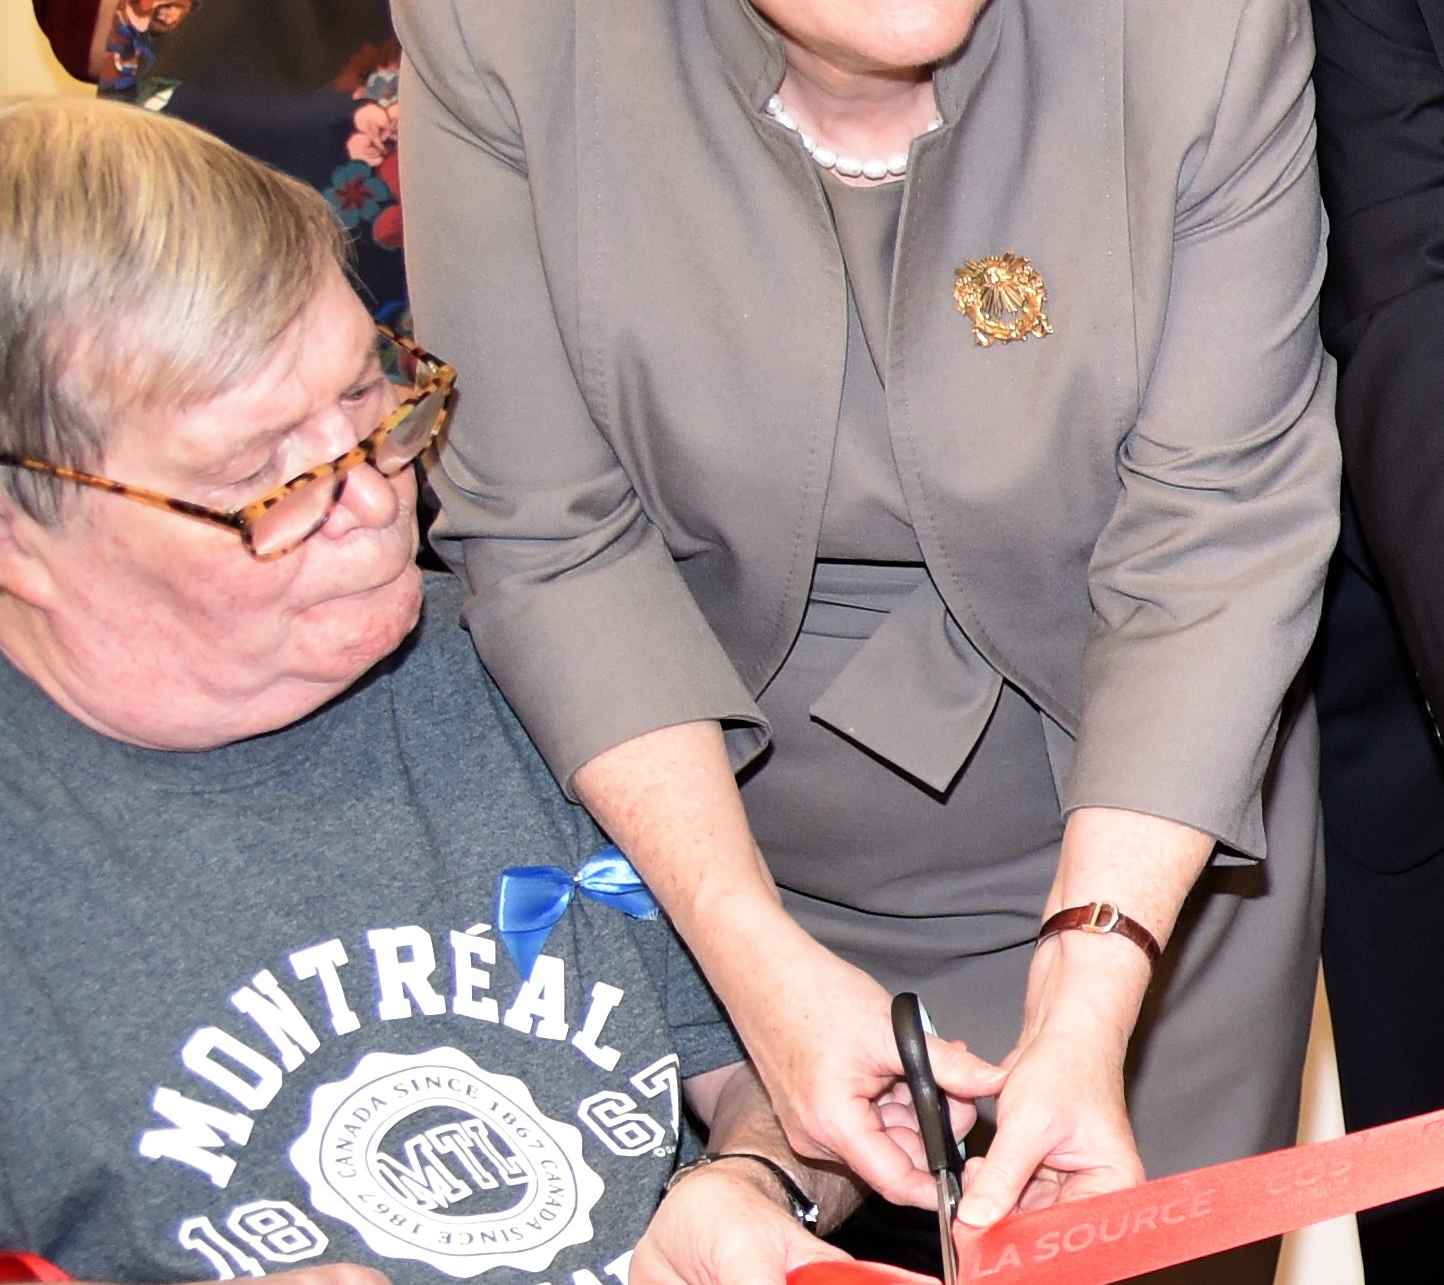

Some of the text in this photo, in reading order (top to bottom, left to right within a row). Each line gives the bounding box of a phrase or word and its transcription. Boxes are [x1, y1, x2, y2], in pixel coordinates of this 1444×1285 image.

[138, 922, 624, 1189] MONTRÉAL
[336, 1075, 546, 1179] CANADA SINCE 1867
[375, 1117, 530, 1211] MTL
[178, 1199, 330, 1281] 18
[356, 1159, 567, 1247] CANADA SINCE 1867
[970, 1249, 1022, 1278] LA
[1033, 1190, 1213, 1263] SOURCE
